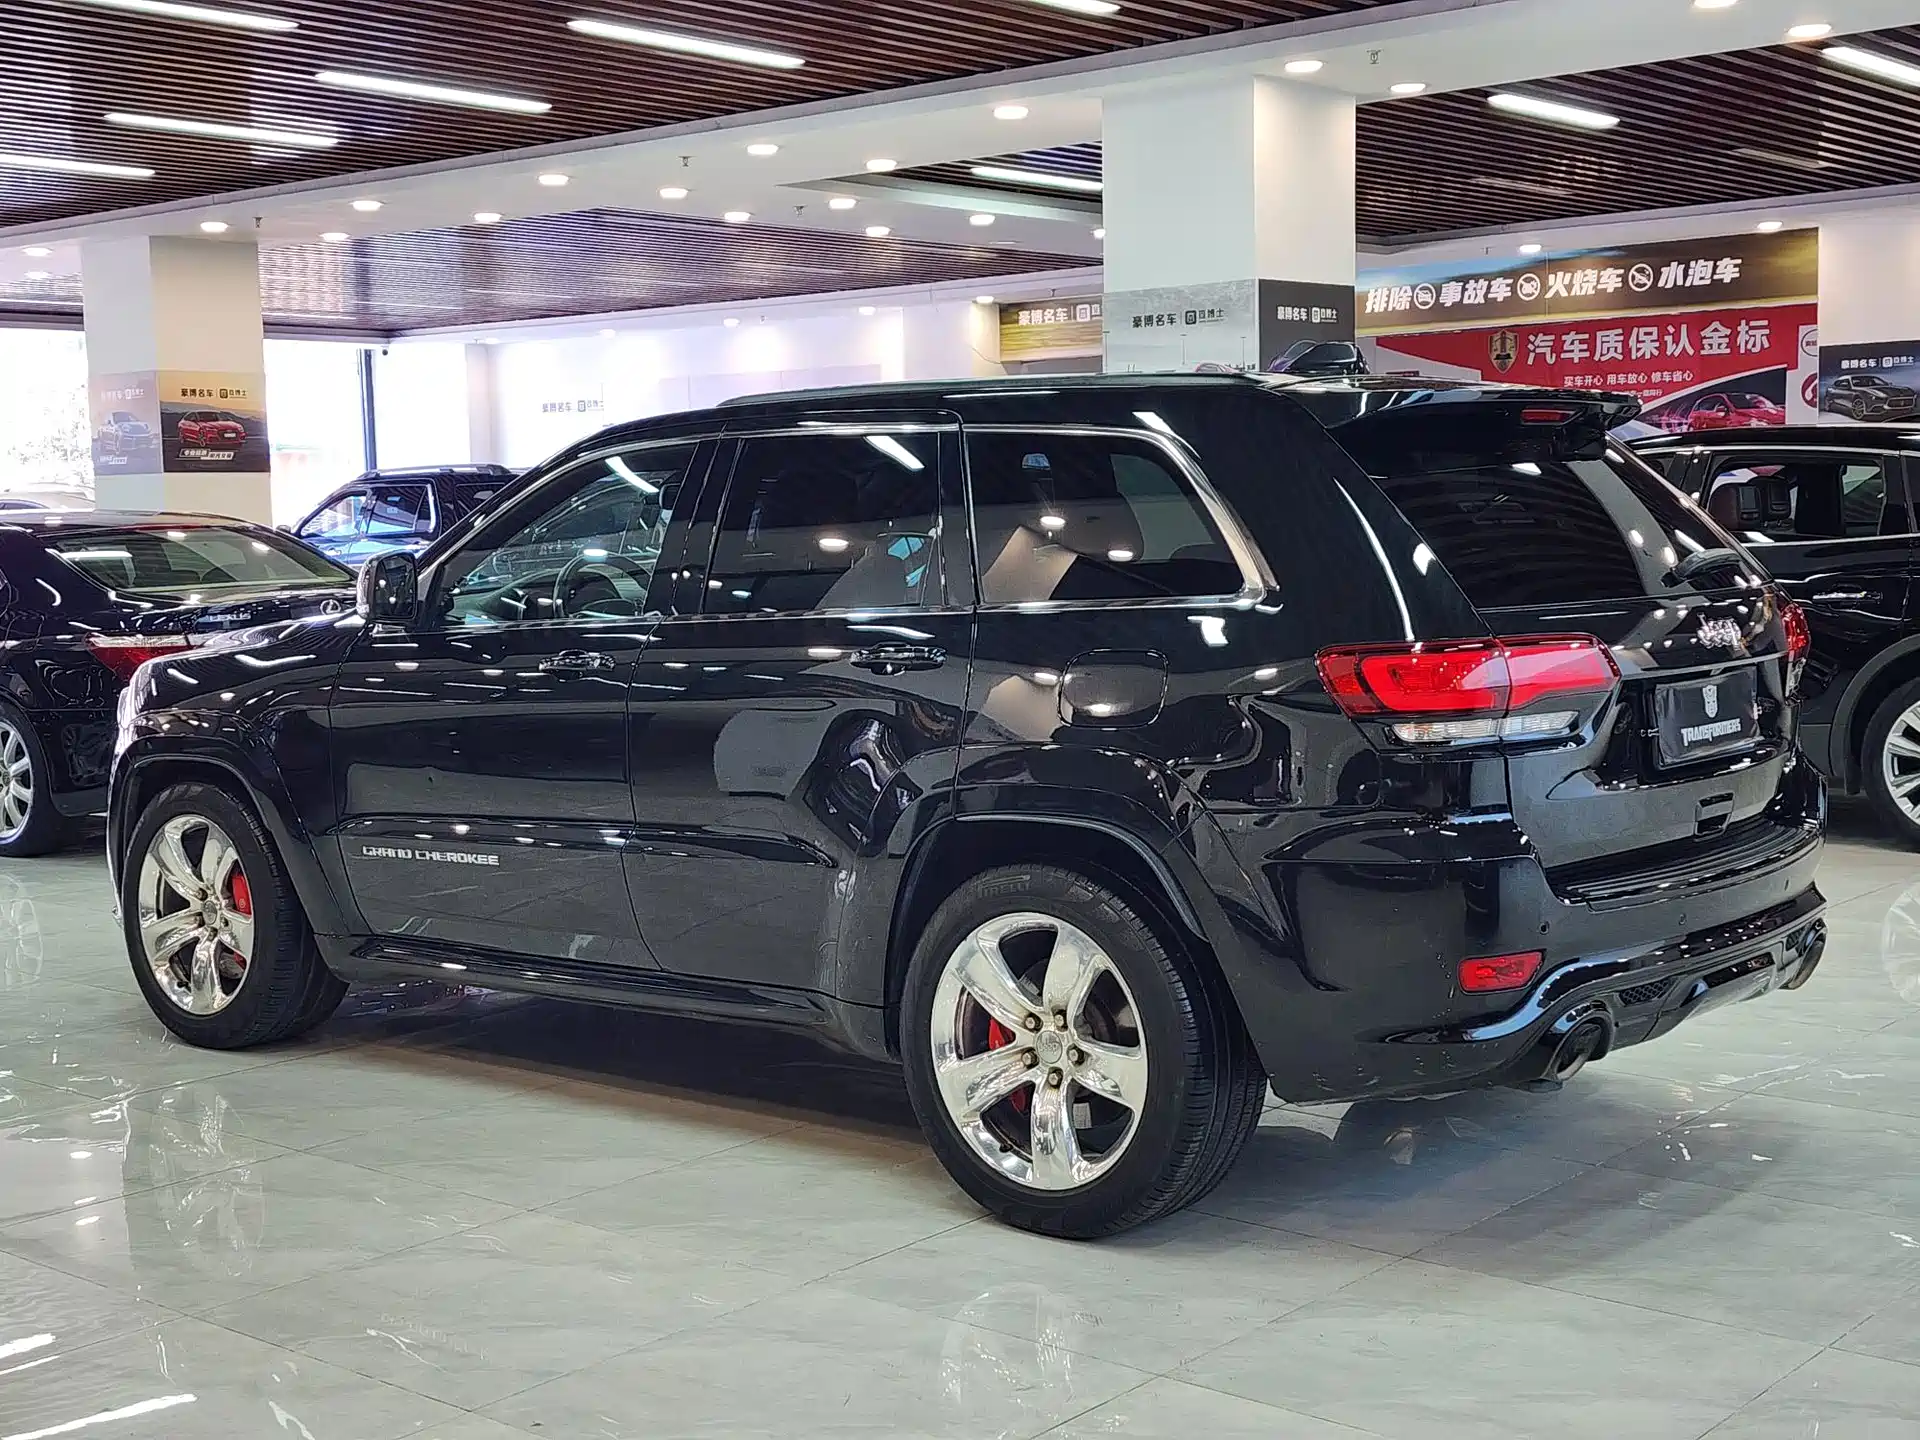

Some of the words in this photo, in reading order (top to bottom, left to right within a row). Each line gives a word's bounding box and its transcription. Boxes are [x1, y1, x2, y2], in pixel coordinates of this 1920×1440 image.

[1365, 285, 1412, 313] 排除
[1440, 277, 1514, 307] 事故车
[1544, 267, 1625, 299] 火烧车
[1658, 257, 1742, 288] 水泡车
[1132, 313, 1177, 328] 豪博名车
[1527, 320, 1770, 365] 汽车质保认金标
[1563, 375, 1604, 387] 买车开心
[1606, 372, 1648, 385] 用车放心
[210, 613, 251, 621] LEXUS
[362, 846, 412, 859] GRAND
[415, 850, 500, 866] CHEROKEE
